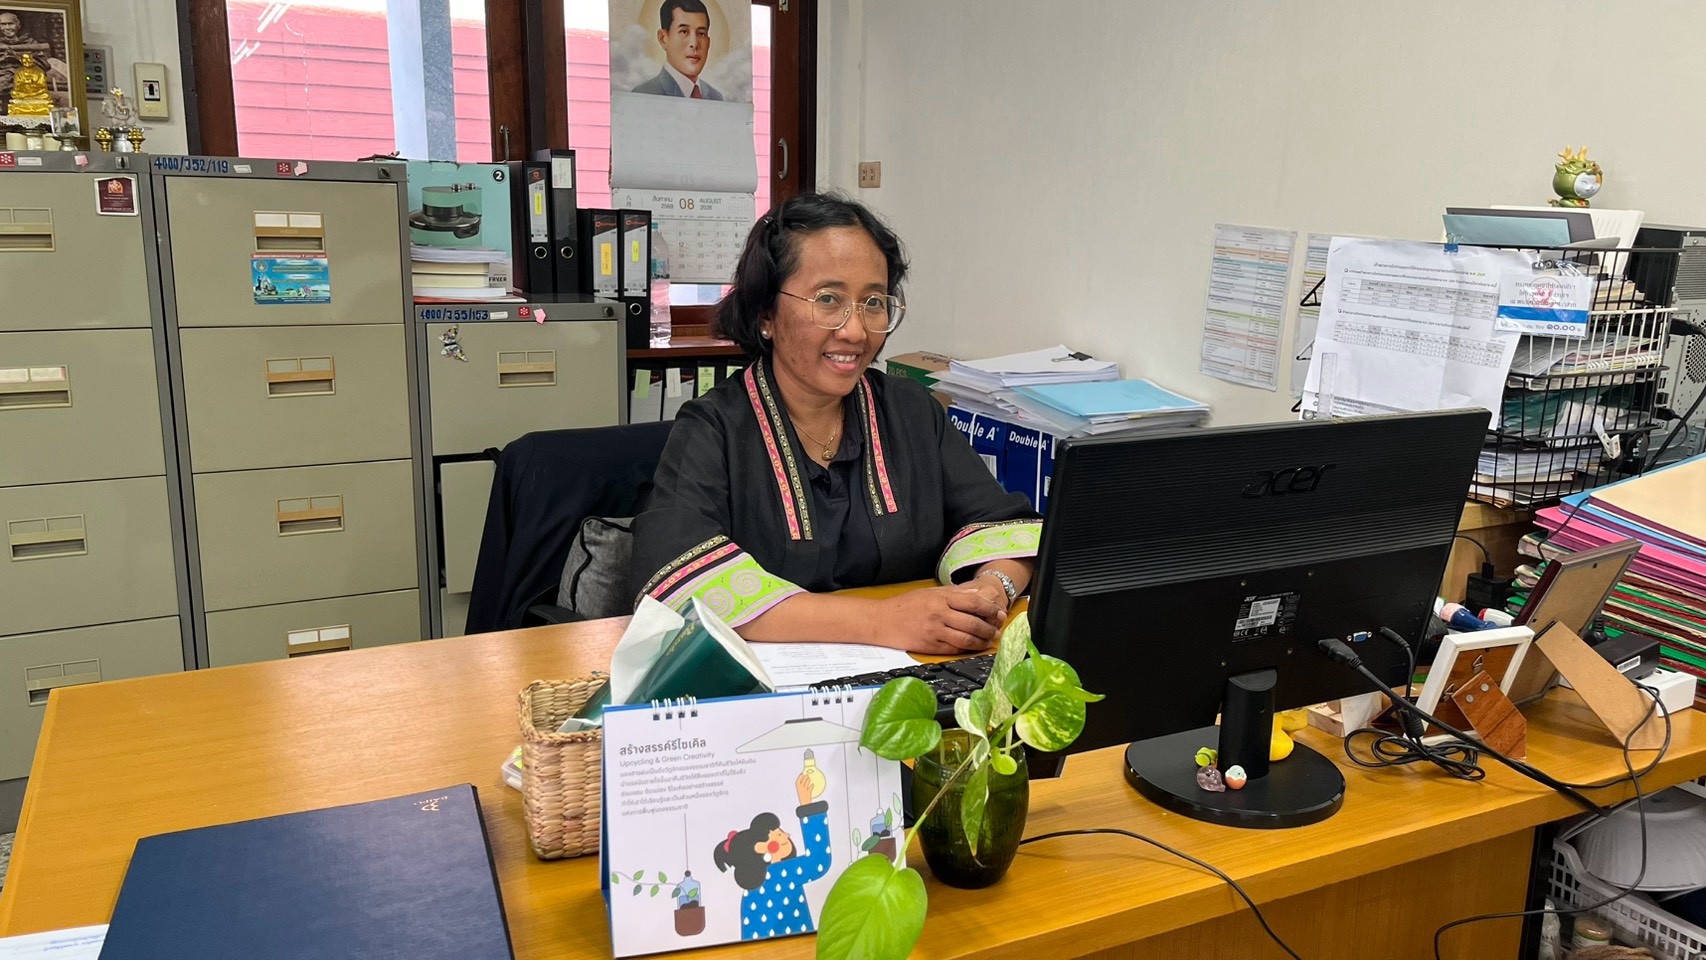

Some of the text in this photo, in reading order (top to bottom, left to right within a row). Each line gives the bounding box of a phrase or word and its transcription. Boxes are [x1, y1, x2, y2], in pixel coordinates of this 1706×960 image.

[495, 171, 503, 180] 2
[679, 198, 695, 210] 08
[986, 426, 996, 441] A
[1009, 430, 1047, 451] Double A
[1240, 463, 1337, 498] acer
[619, 738, 707, 755] สร้างสรรค์รีไซเคิล
[619, 758, 654, 767] Upcycling
[661, 755, 683, 763] Green
[683, 752, 715, 760] Creativity
